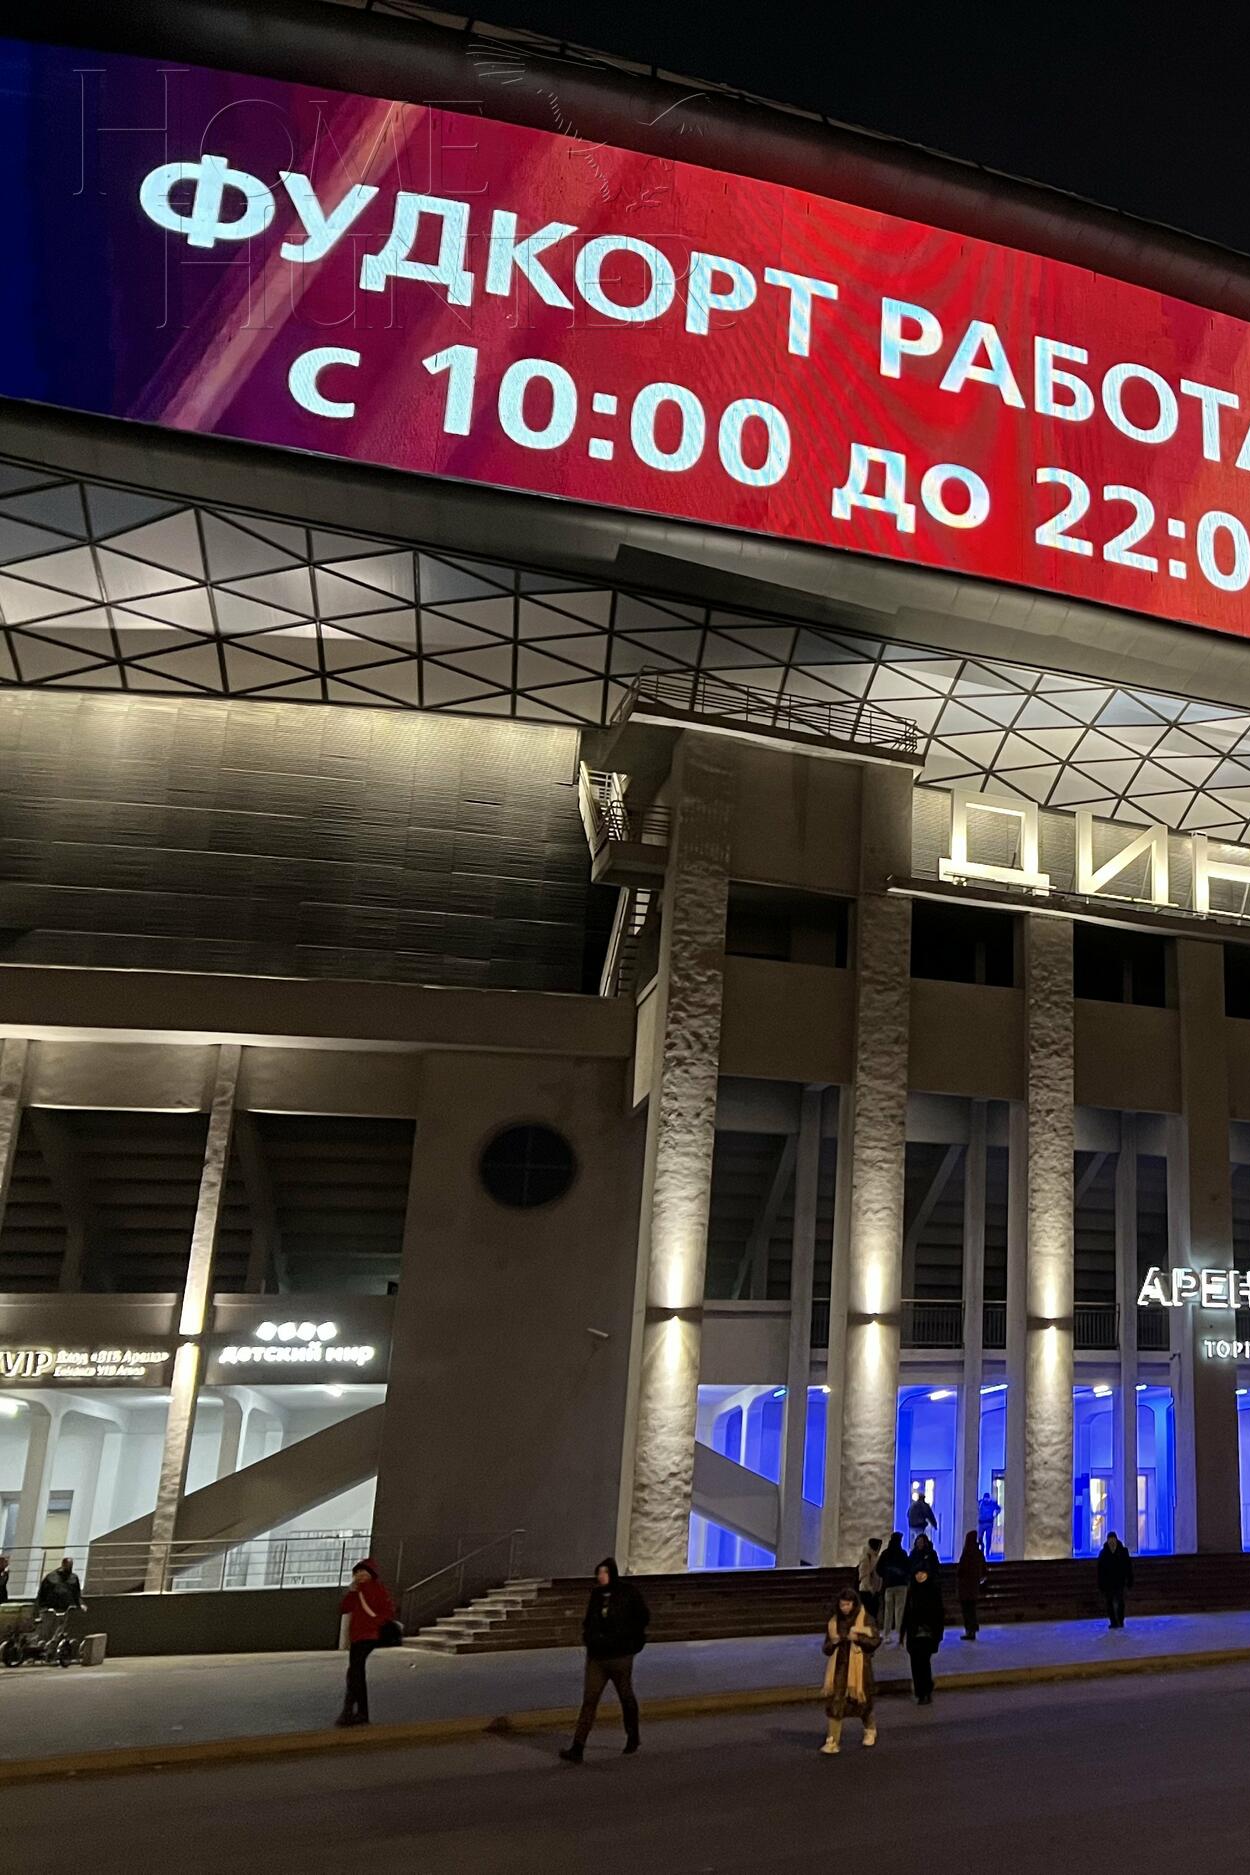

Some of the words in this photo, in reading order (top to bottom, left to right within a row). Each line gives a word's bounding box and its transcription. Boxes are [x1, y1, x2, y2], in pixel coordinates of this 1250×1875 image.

[140, 155, 838, 356] ФУДКОРТ
[423, 345, 790, 486] 10:00
[832, 443, 989, 533] до
